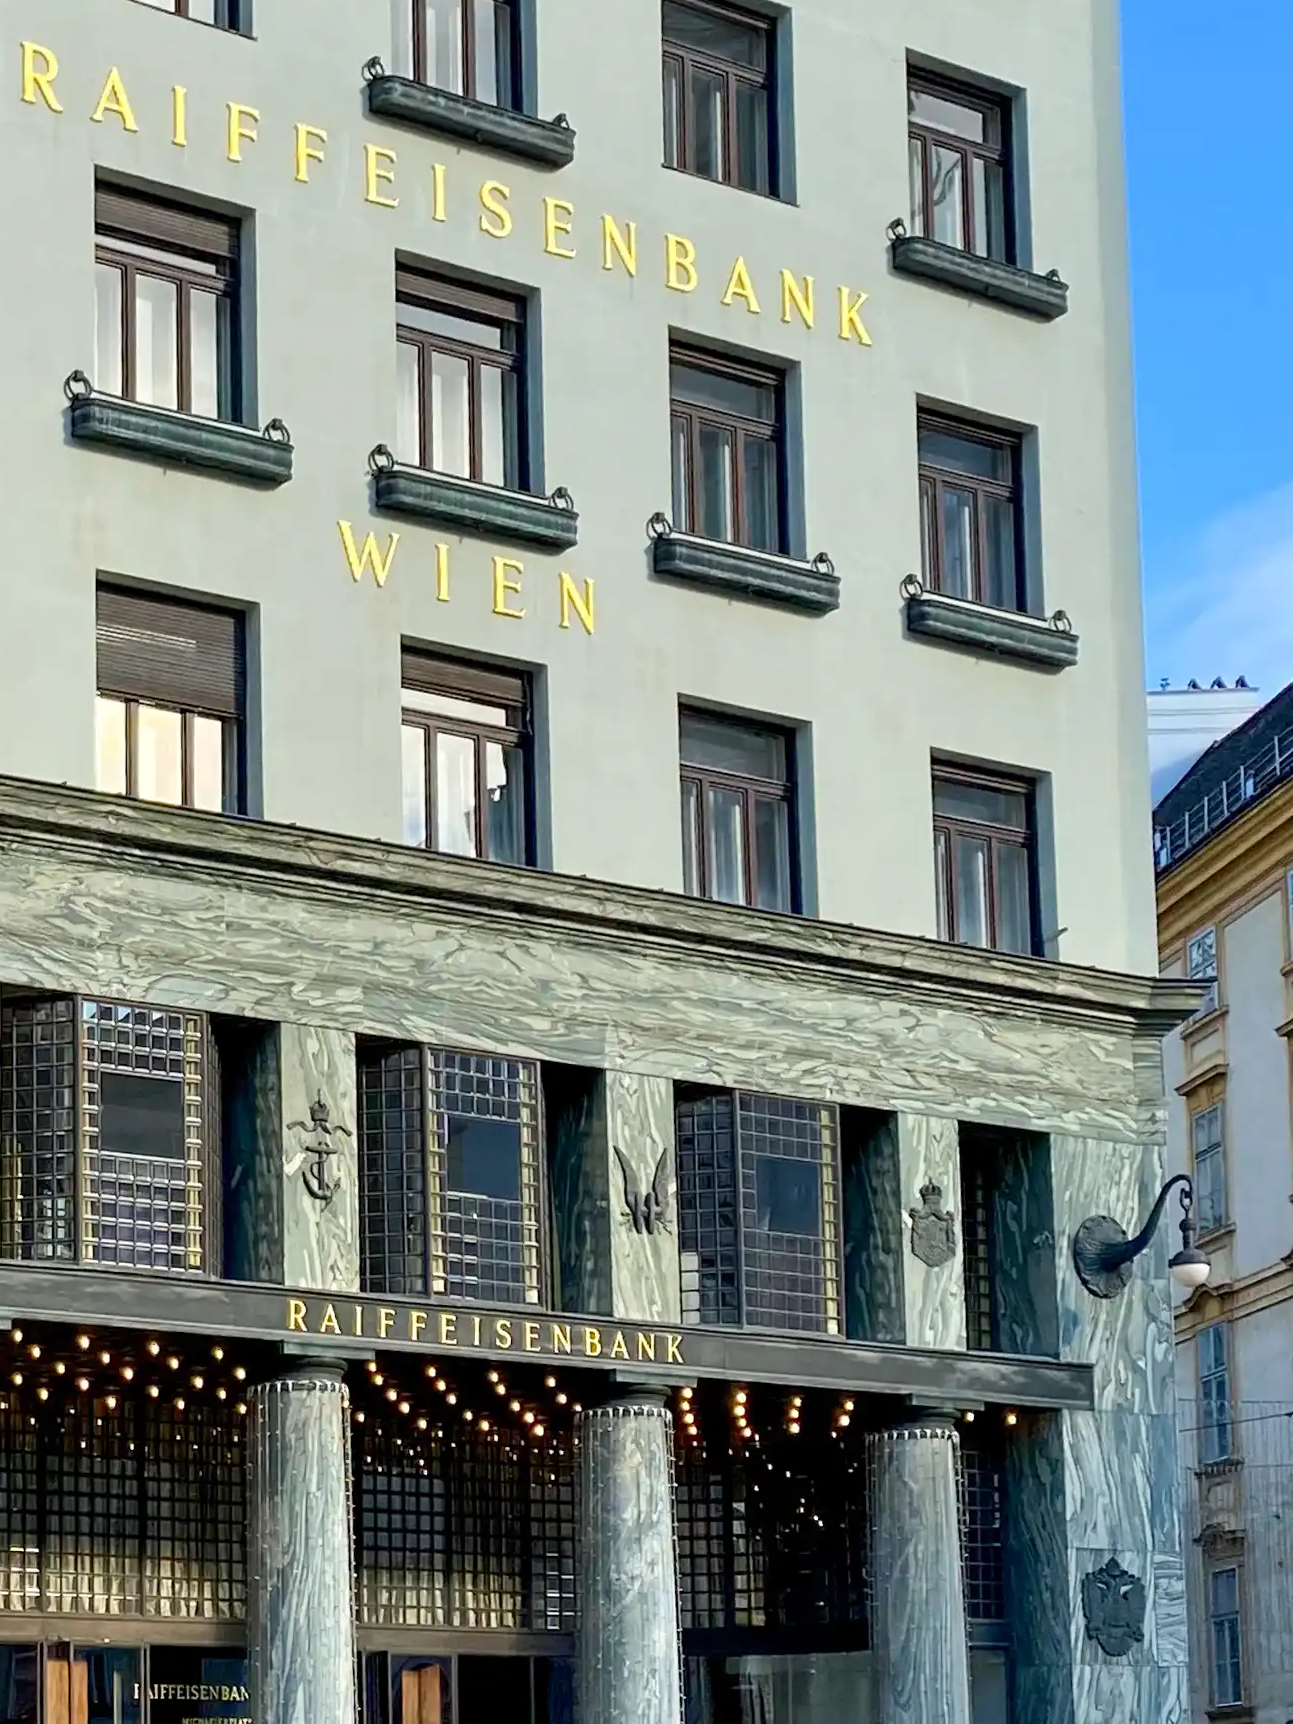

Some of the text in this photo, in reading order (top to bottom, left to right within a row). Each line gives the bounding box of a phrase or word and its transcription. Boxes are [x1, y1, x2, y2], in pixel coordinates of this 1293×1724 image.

[20, 40, 874, 347] RAIFFEISENBANK
[336, 519, 595, 636] WIEN
[286, 1299, 685, 1365] RAIFFEISENBANK
